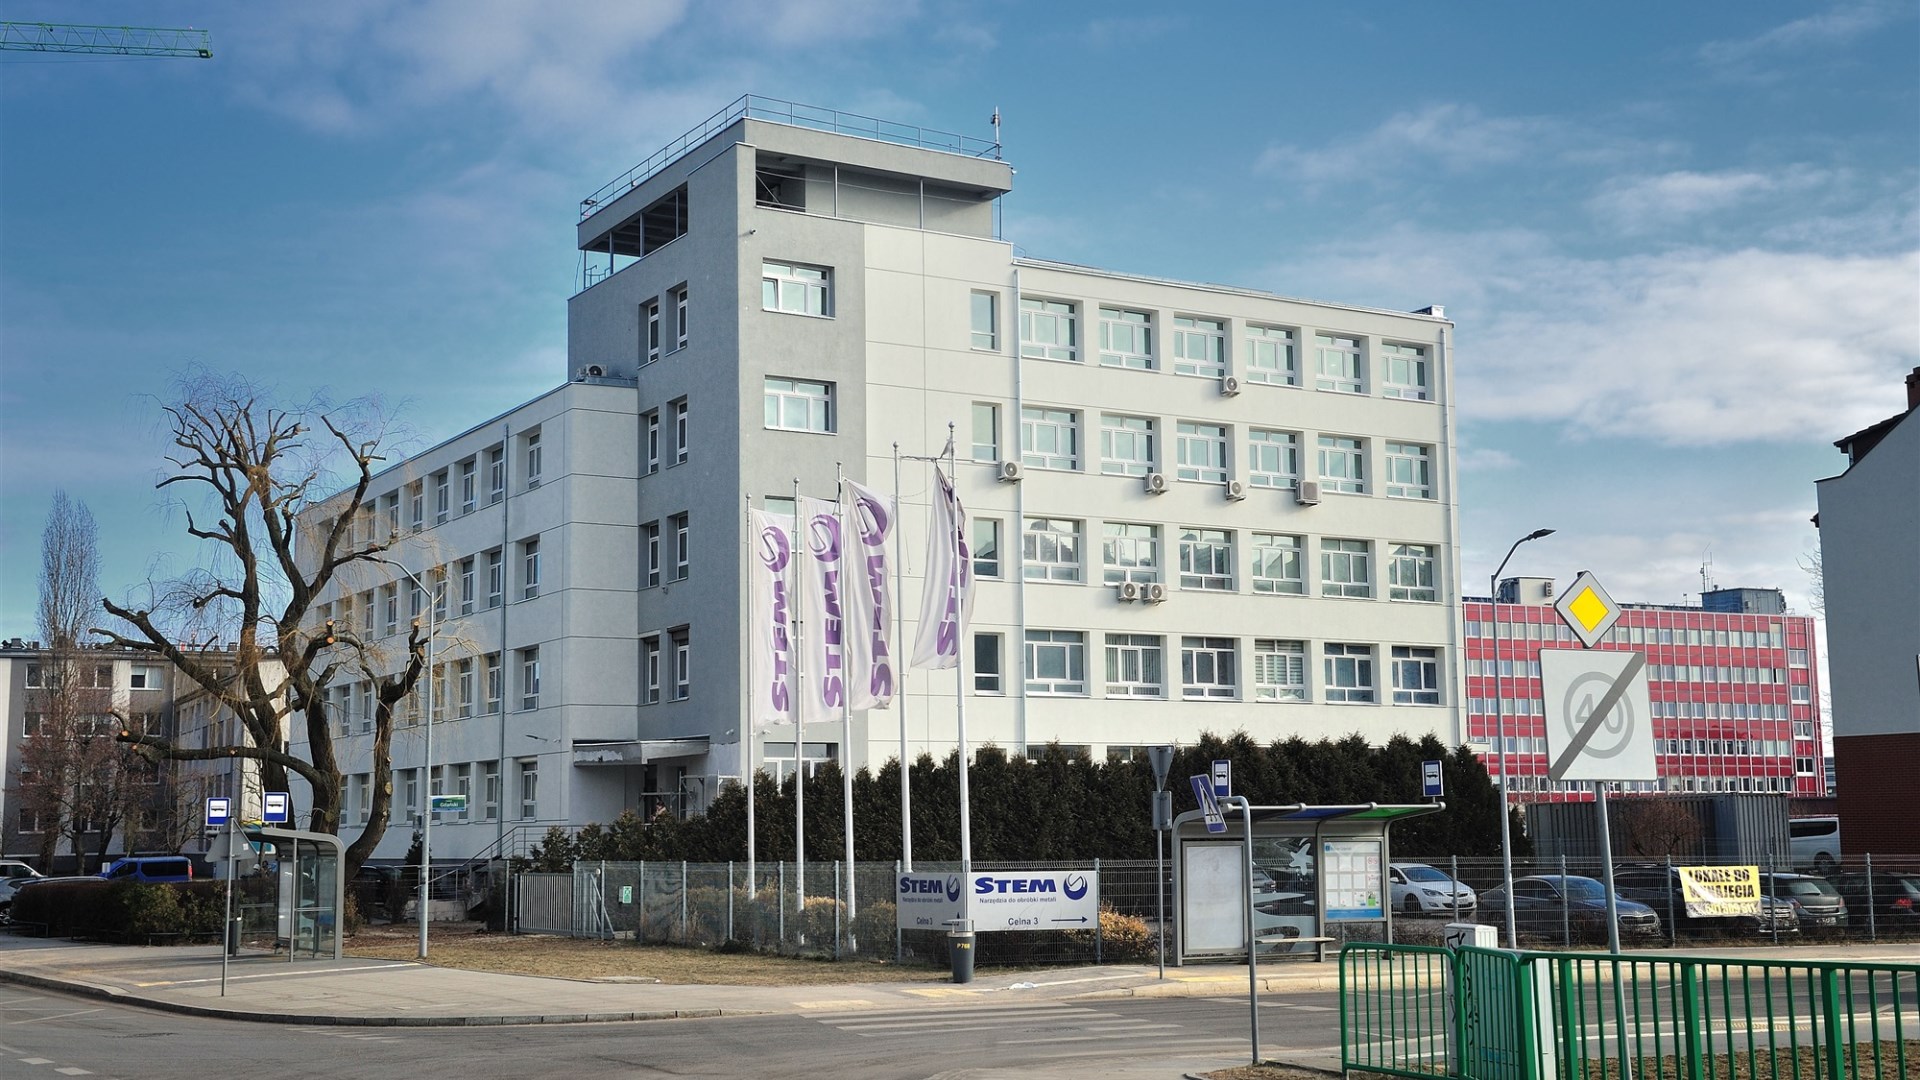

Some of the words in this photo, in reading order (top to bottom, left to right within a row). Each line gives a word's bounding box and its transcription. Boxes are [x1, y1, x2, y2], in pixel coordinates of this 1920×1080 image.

[771, 580, 790, 712] STEM
[823, 570, 844, 708] STEM
[1574, 693, 1624, 735] 40
[900, 876, 943, 893] STEM
[974, 876, 1057, 894] STEM
[979, 897, 1007, 905] Narzędzia
[1008, 917, 1032, 926] Celna
[1033, 917, 1039, 925] 3
